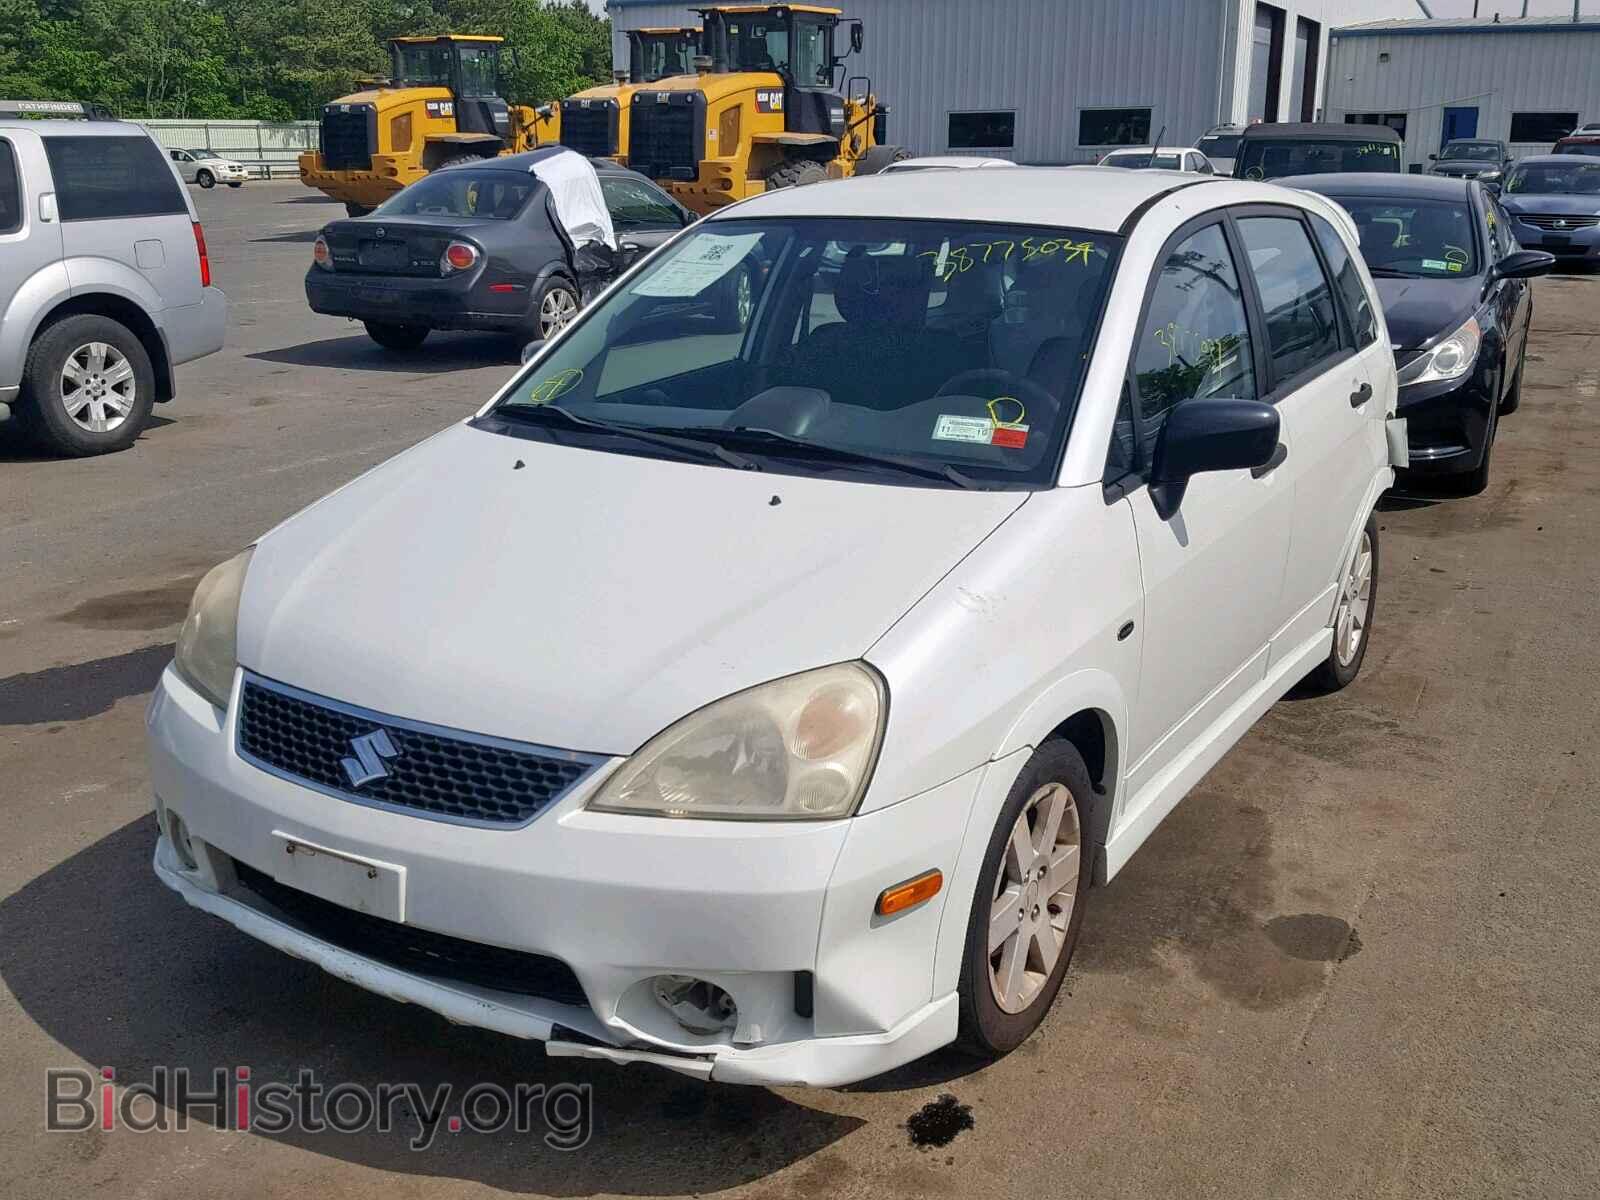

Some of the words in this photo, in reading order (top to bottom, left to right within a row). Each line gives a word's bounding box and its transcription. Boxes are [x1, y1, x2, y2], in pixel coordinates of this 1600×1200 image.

[657, 93, 670, 103] CAT
[769, 93, 783, 109] CAT
[18, 103, 80, 111] PATHFINDER
[440, 102, 453, 115] CAT
